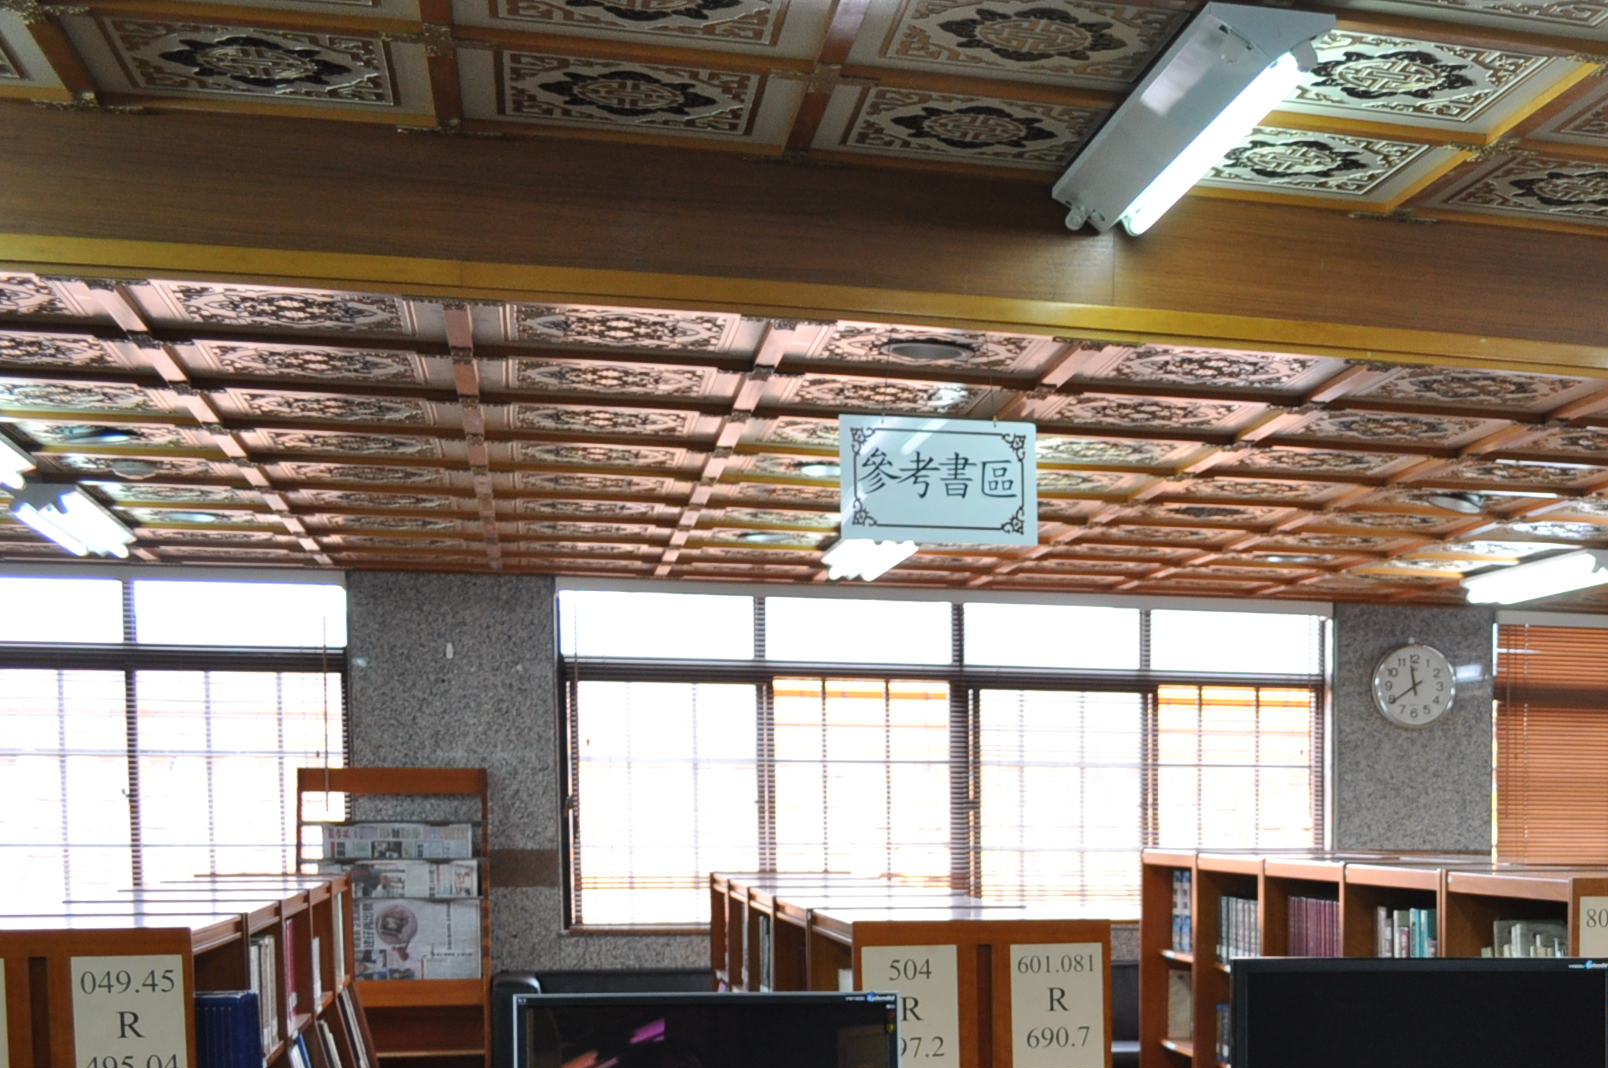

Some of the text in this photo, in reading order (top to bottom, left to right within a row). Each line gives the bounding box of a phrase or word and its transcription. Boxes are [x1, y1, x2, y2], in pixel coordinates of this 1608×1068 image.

[858, 447, 1017, 499] 參考書區
[1397, 658, 1406, 667] 11
[1409, 654, 1420, 664] 12
[1426, 658, 1430, 667] 1
[1387, 667, 1398, 677] 10
[1433, 667, 1441, 677] 2
[1385, 681, 1393, 691] 9
[1436, 682, 1443, 692] 3
[1432, 695, 1440, 704] 4
[1399, 704, 1406, 714] 7
[1410, 708, 1418, 718] 6
[1423, 705, 1431, 715] 5
[1017, 953, 1095, 974] 601.081
[888, 958, 932, 981] 504
[80, 969, 175, 995] 049.45
[1048, 986, 1070, 1012] R
[901, 996, 923, 1021] R
[116, 1010, 146, 1039] R
[1026, 1026, 1090, 1049] 690.7
